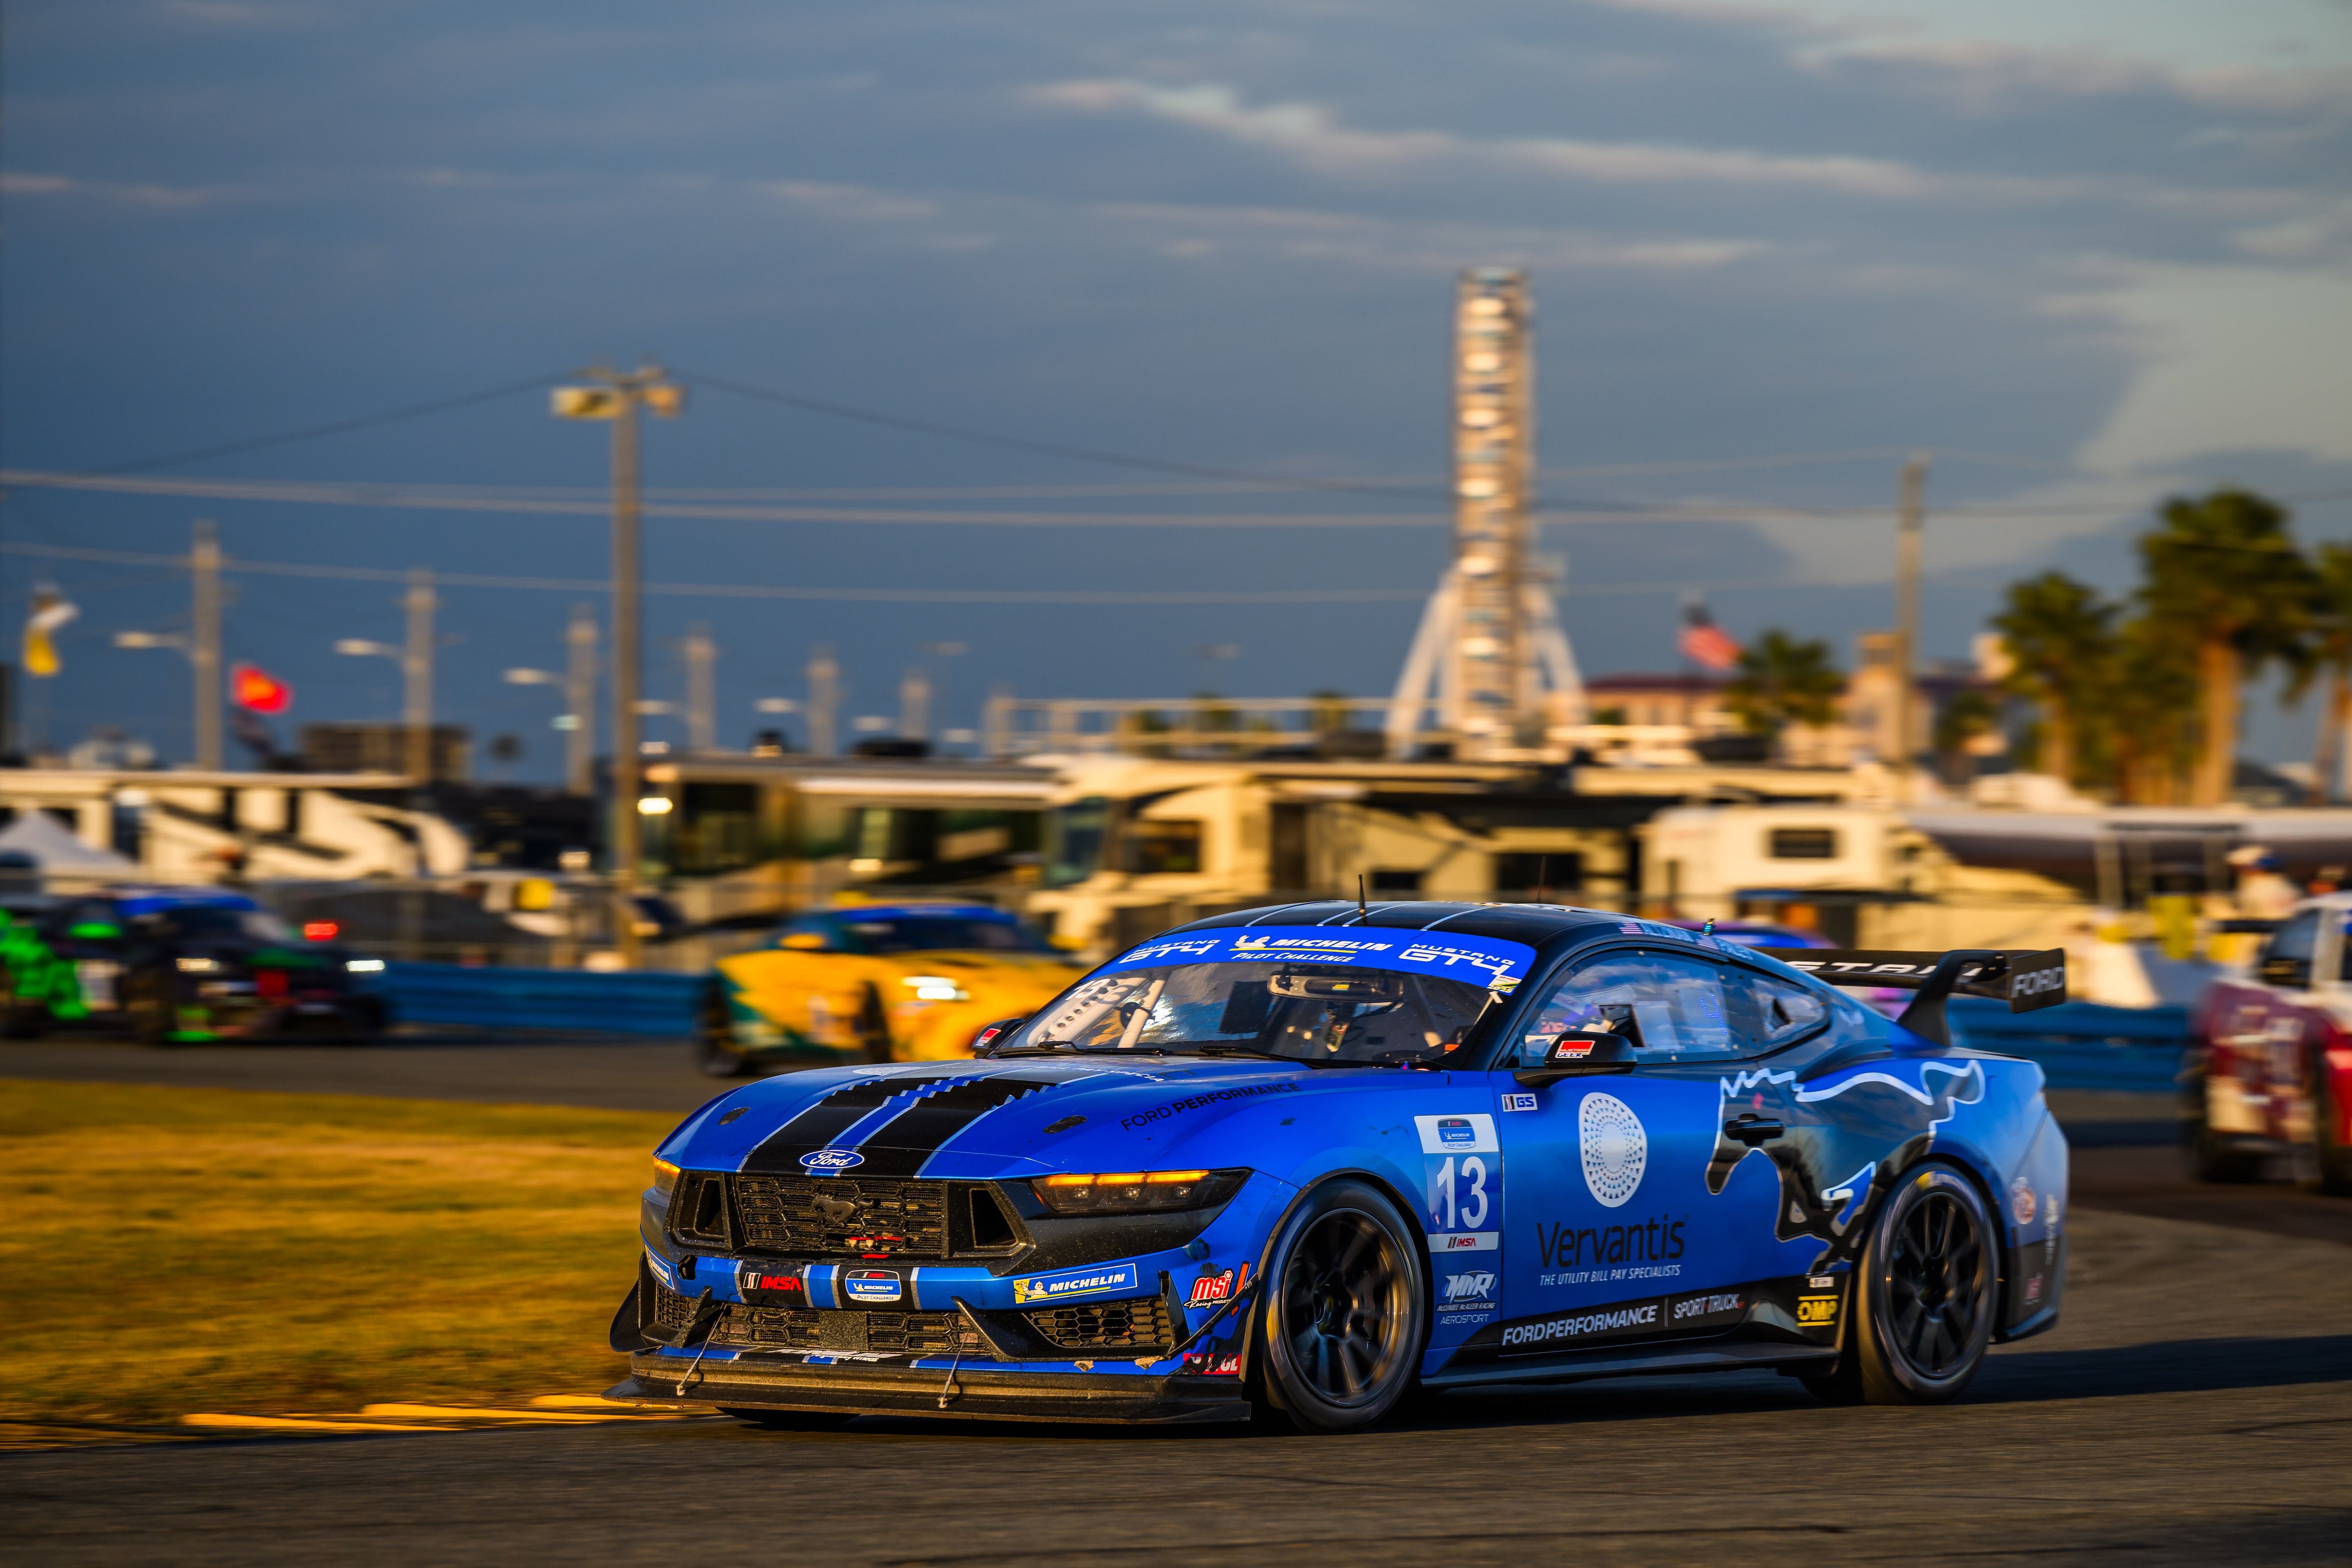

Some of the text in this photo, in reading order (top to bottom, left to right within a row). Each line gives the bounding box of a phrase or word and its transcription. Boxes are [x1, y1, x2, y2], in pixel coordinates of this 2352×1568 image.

[1119, 944, 1216, 964] GT4
[1133, 939, 1221, 953] MUSTANG
[1270, 939, 1393, 951] MICHELIN
[1410, 943, 1516, 966] MUSTANG
[1274, 952, 1356, 962] CHALLENGE
[1398, 948, 1511, 976] GT4
[1065, 978, 1111, 1001] 13
[2011, 966, 2065, 998] FORD
[1120, 1083, 1302, 1131] FORD PERFORMANCE
[1516, 1097, 1534, 1108] GS
[810, 1152, 854, 1166] Ford
[1437, 1156, 1488, 1228] 13
[1456, 1237, 1477, 1247] IMSA
[1537, 1213, 1685, 1268] Vervantis
[760, 1276, 803, 1291] IMSA
[1049, 1274, 1125, 1292] MICHELIN
[1540, 1264, 1682, 1285] THE UTILITY BILL PAY SPECIALISTS
[1445, 1274, 1495, 1304] MMR
[1184, 1300, 1212, 1309] Racing
[1674, 1294, 1740, 1319] SPORT TRUCK
[1797, 1300, 1838, 1321] OMP
[1440, 1314, 1490, 1324] AEROSPORT
